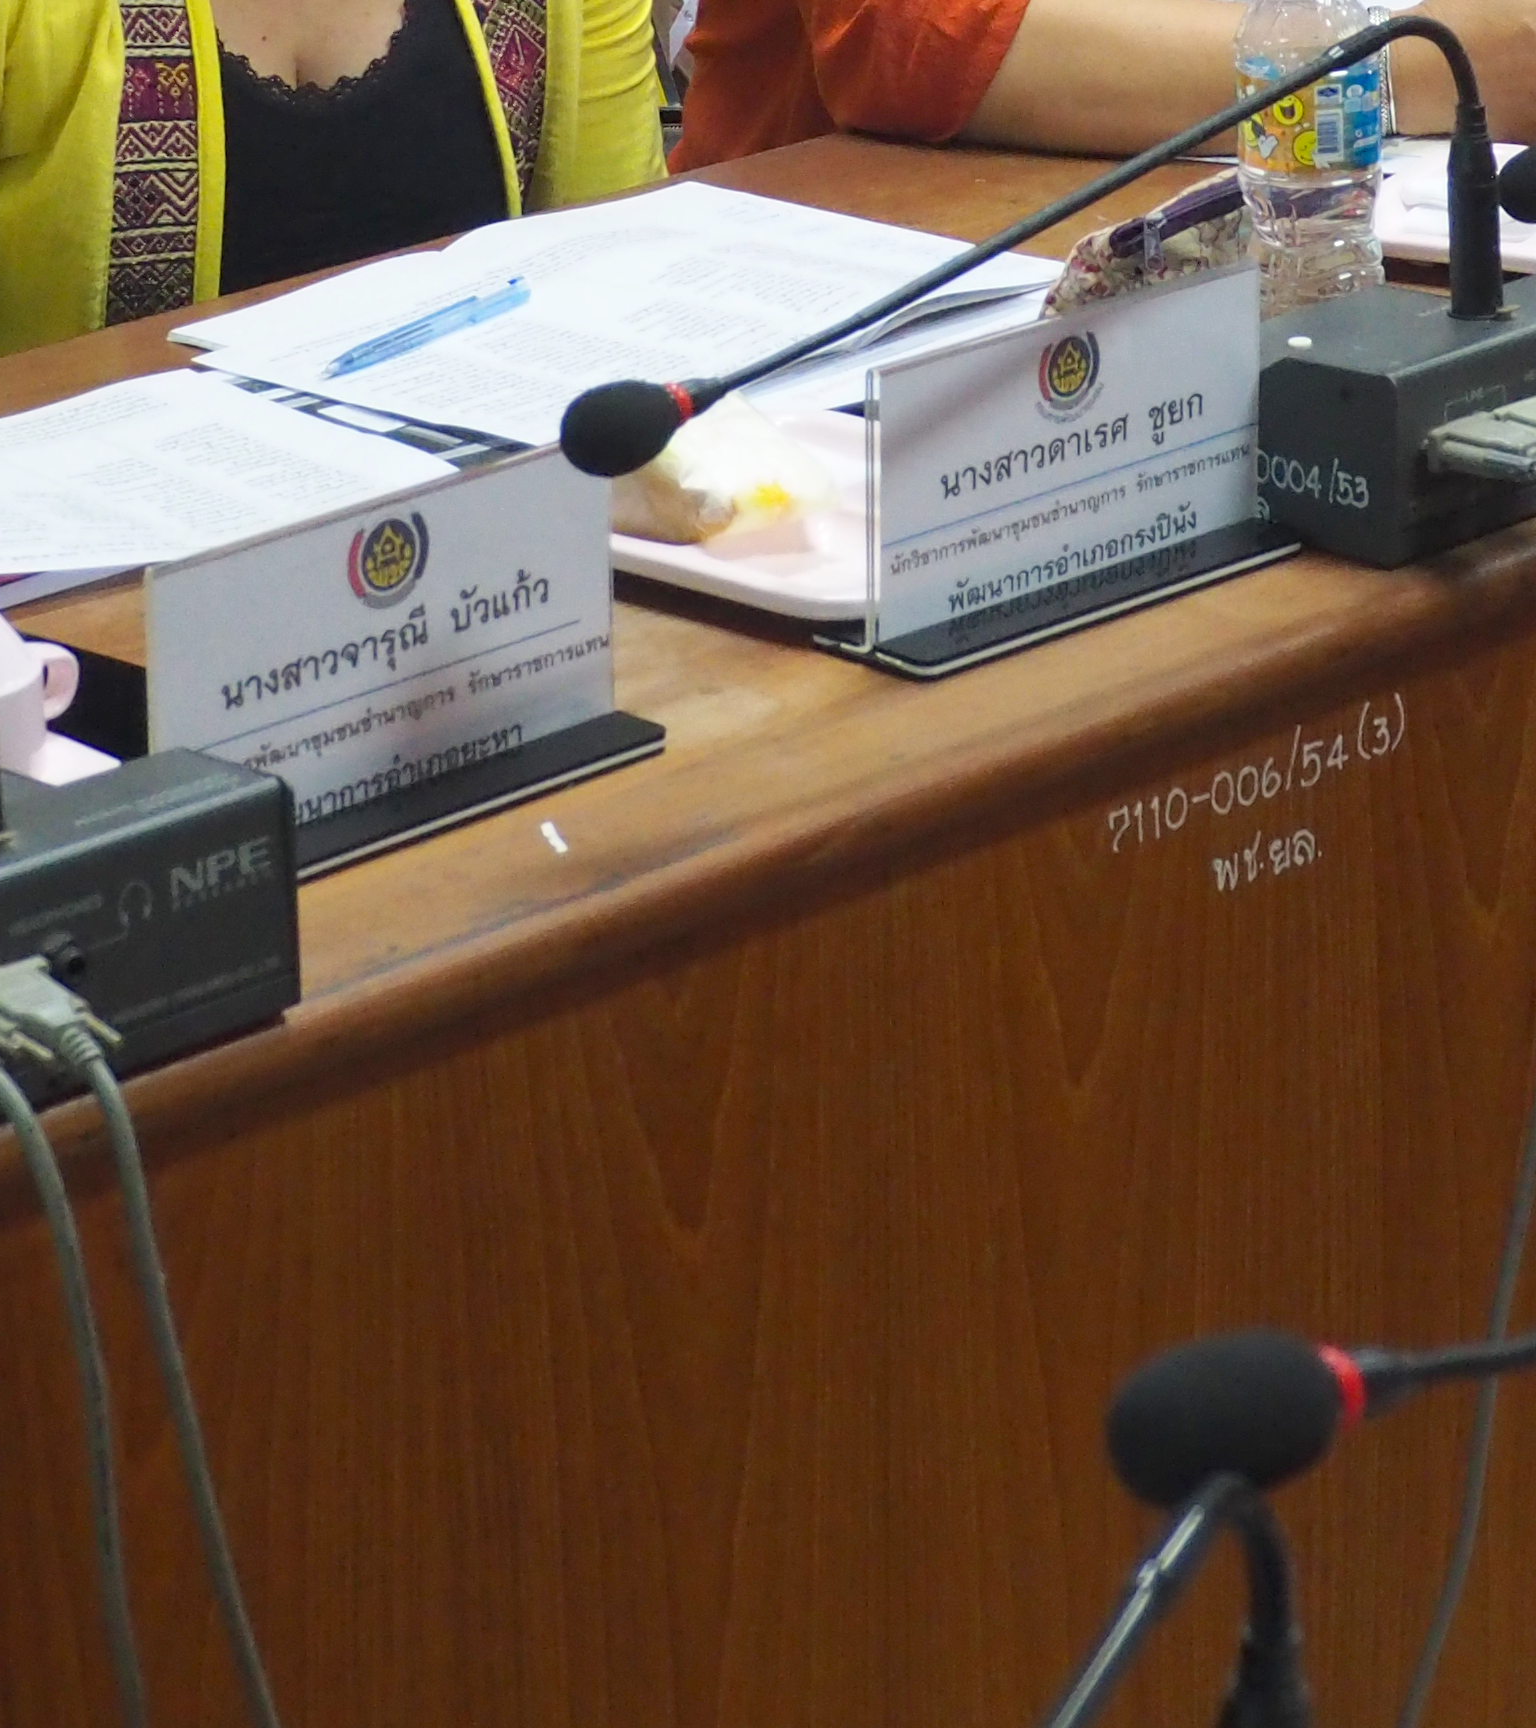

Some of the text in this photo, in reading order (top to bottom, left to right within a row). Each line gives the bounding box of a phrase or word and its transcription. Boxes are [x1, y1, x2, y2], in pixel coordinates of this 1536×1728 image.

[449, 568, 551, 634] บัวแก้ว
[169, 835, 271, 900] NPE
